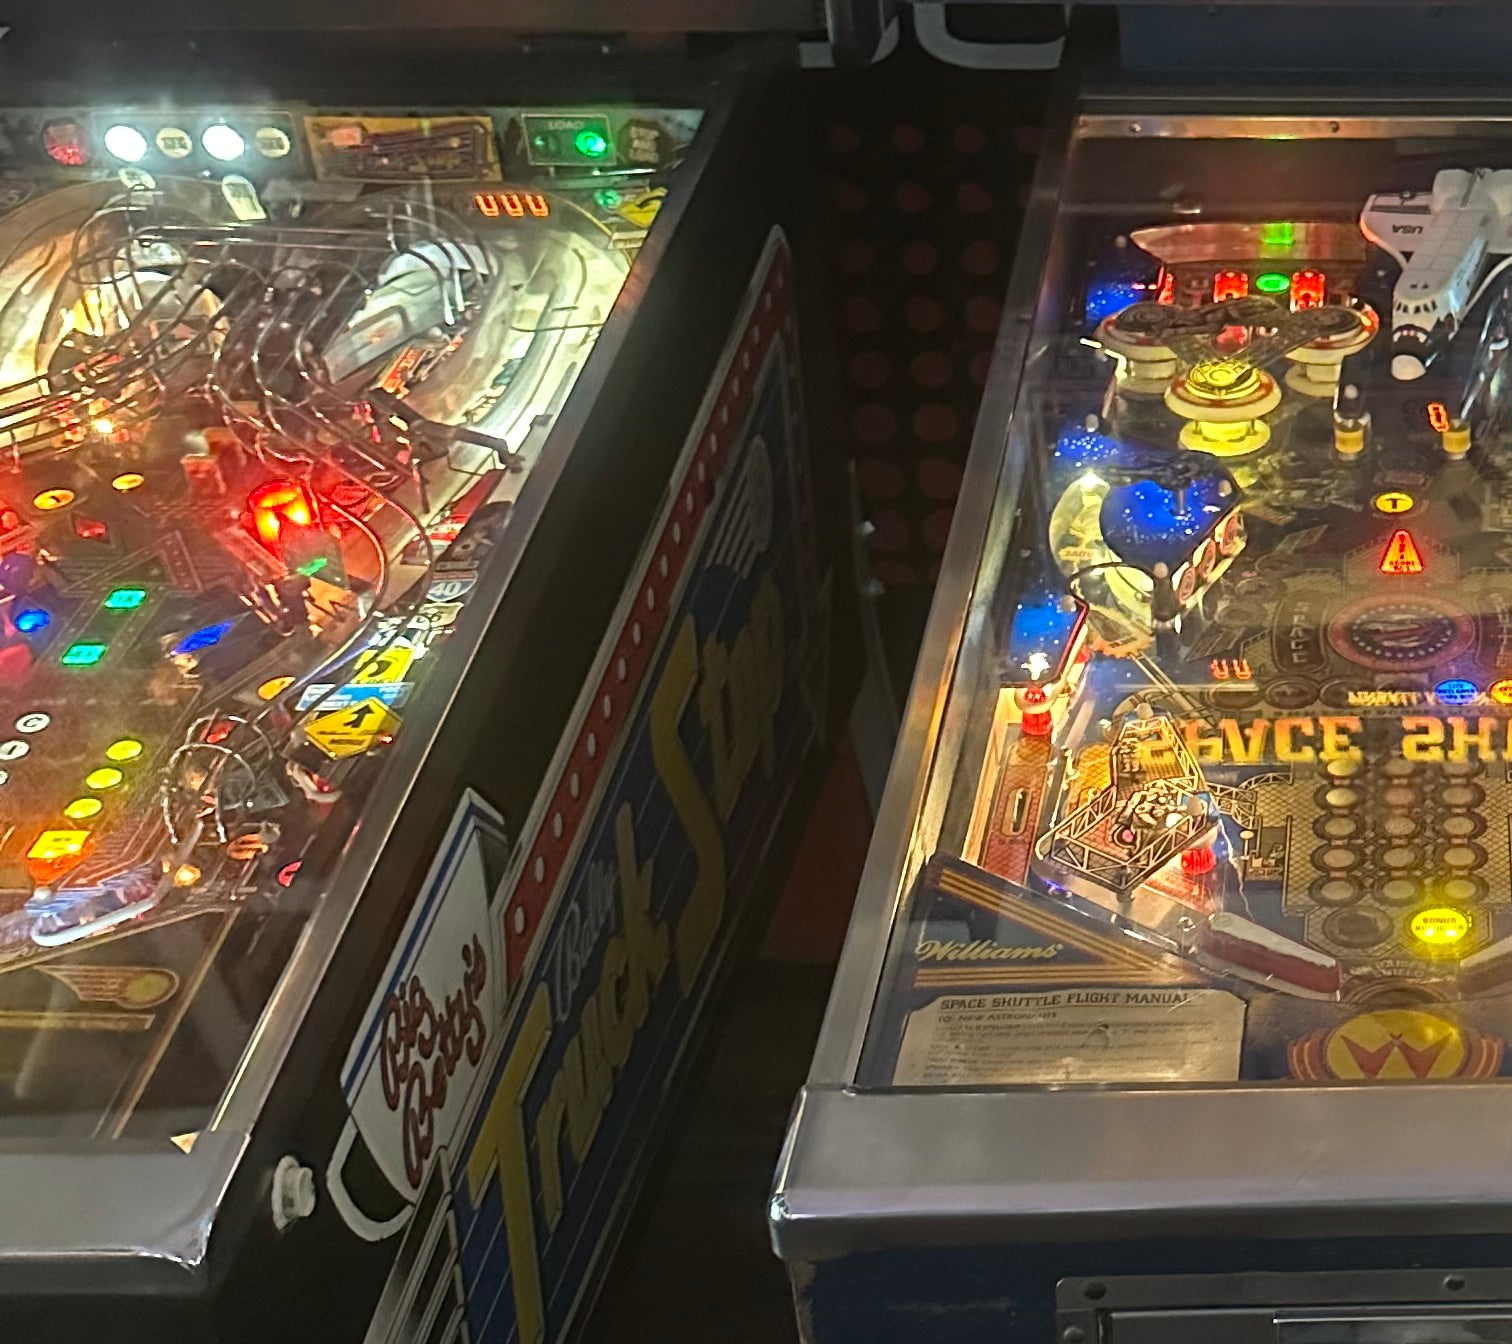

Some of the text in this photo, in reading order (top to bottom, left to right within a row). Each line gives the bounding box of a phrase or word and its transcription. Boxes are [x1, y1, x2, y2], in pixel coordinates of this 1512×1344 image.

[431, 582, 462, 597] 40
[914, 939, 1063, 962] Williams
[940, 997, 987, 1011] SPACE
[991, 993, 1062, 1009] SHUTTLE
[1066, 991, 1122, 1005] FLIGHT
[381, 975, 435, 1114] Big
[403, 933, 488, 1190] Betty's
